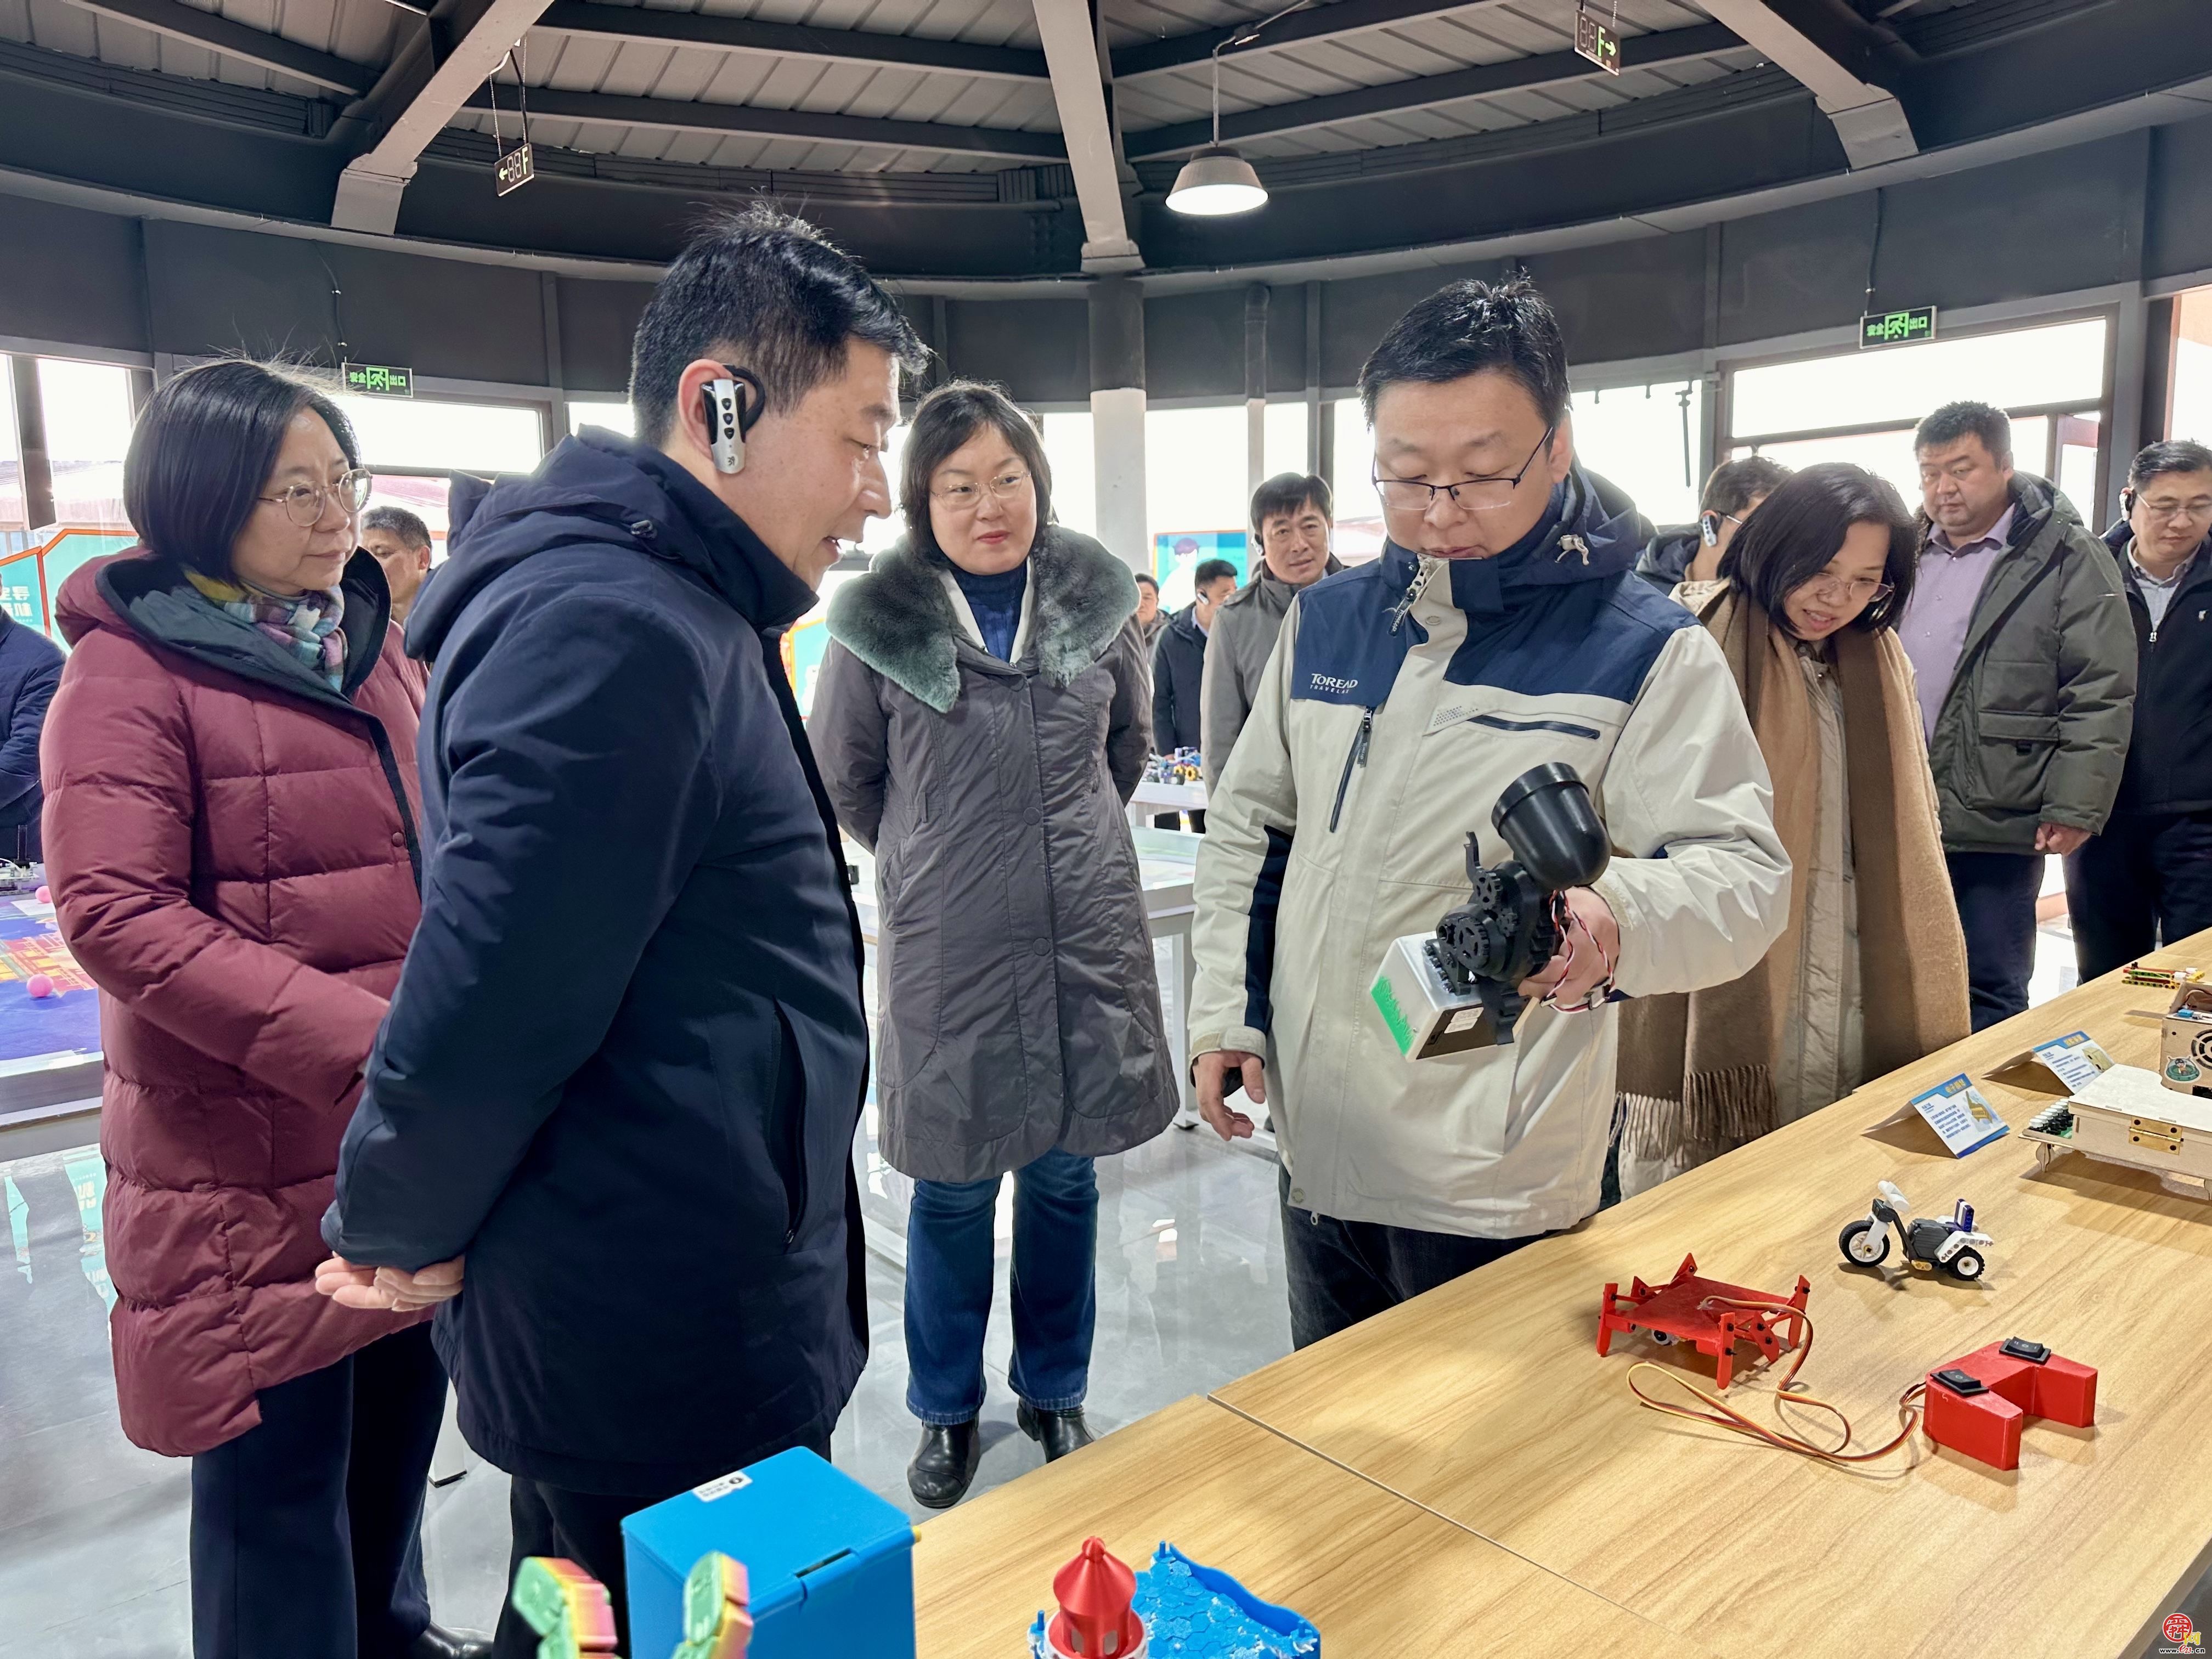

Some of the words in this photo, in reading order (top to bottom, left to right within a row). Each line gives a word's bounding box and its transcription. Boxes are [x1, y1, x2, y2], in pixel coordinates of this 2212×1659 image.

[1909, 316, 1927, 330] 出口
[390, 375, 406, 387] 出口
[1311, 673, 1358, 689] TOREAD
